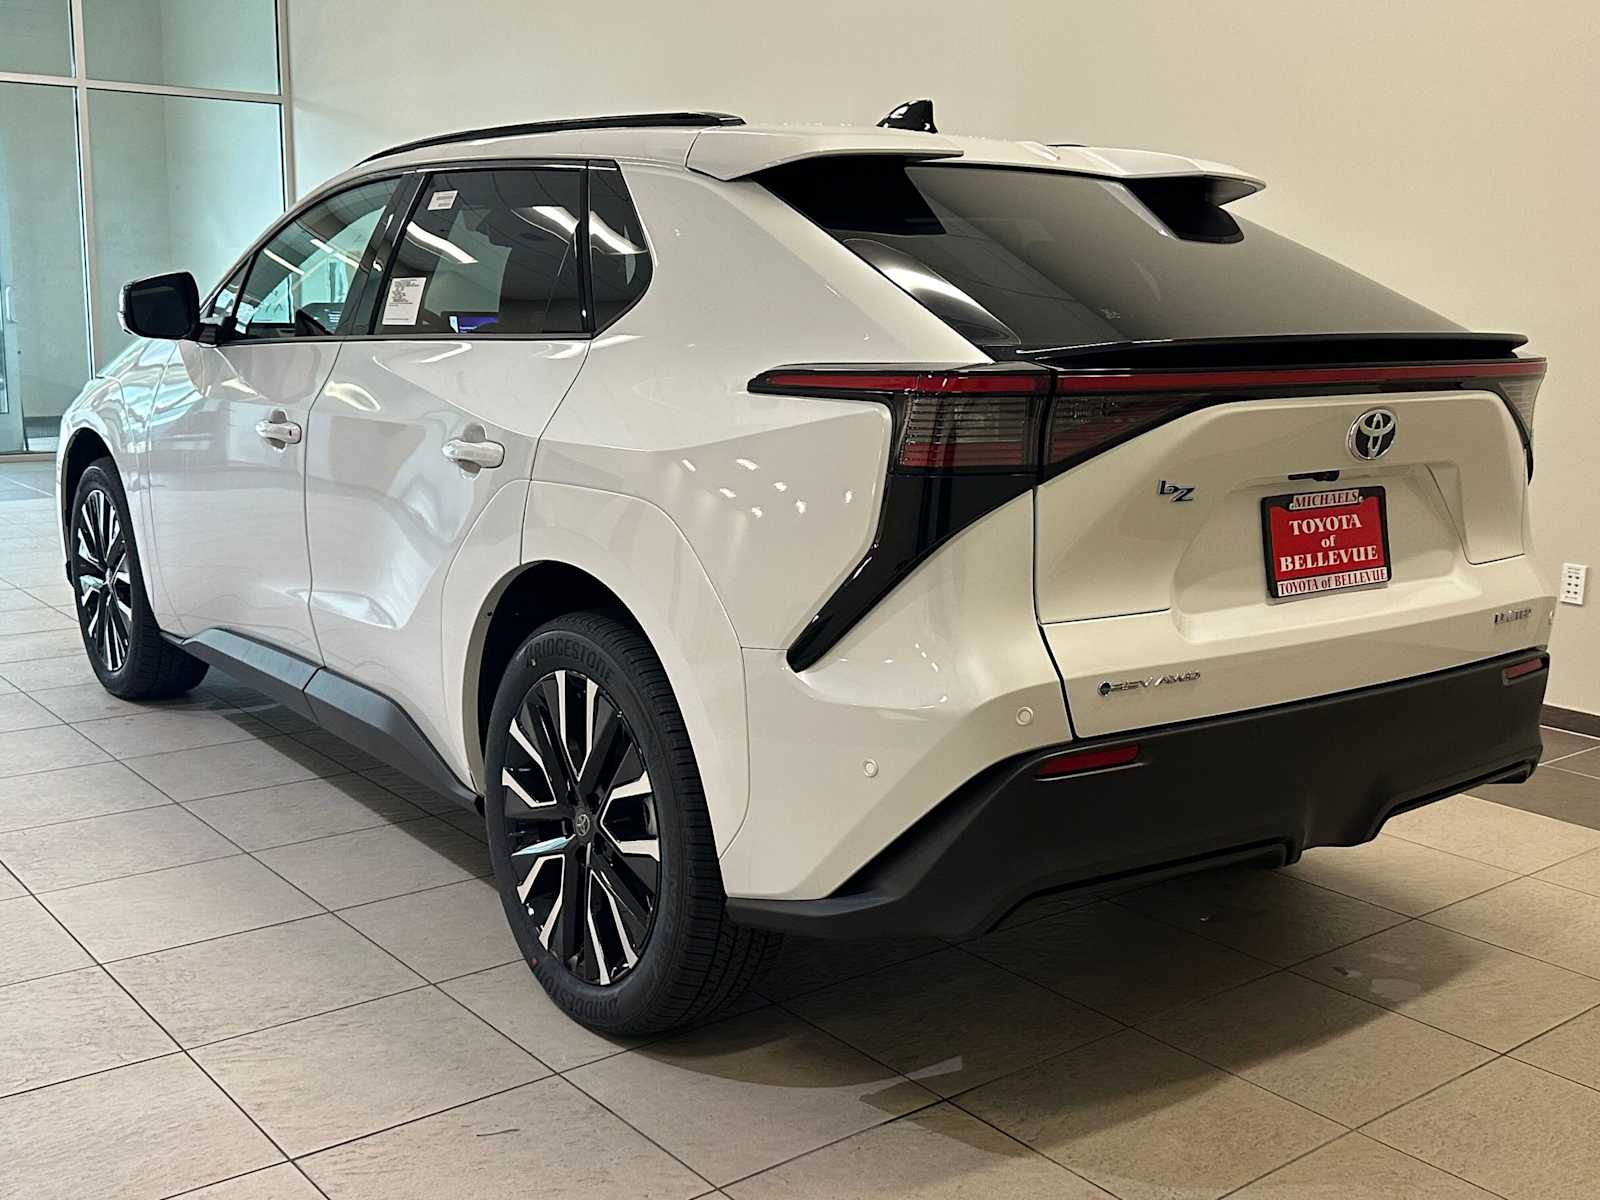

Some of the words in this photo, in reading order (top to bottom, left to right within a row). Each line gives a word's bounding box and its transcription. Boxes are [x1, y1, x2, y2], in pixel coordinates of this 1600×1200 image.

[1295, 490, 1358, 507] MICHAELS
[1289, 514, 1362, 535] TOYOTA
[1321, 535, 1336, 548] of
[1280, 545, 1378, 572] BELLEVUE
[1280, 579, 1318, 595] TOYOTA
[1321, 576, 1332, 589] of
[1335, 568, 1387, 587] BELLEVUE
